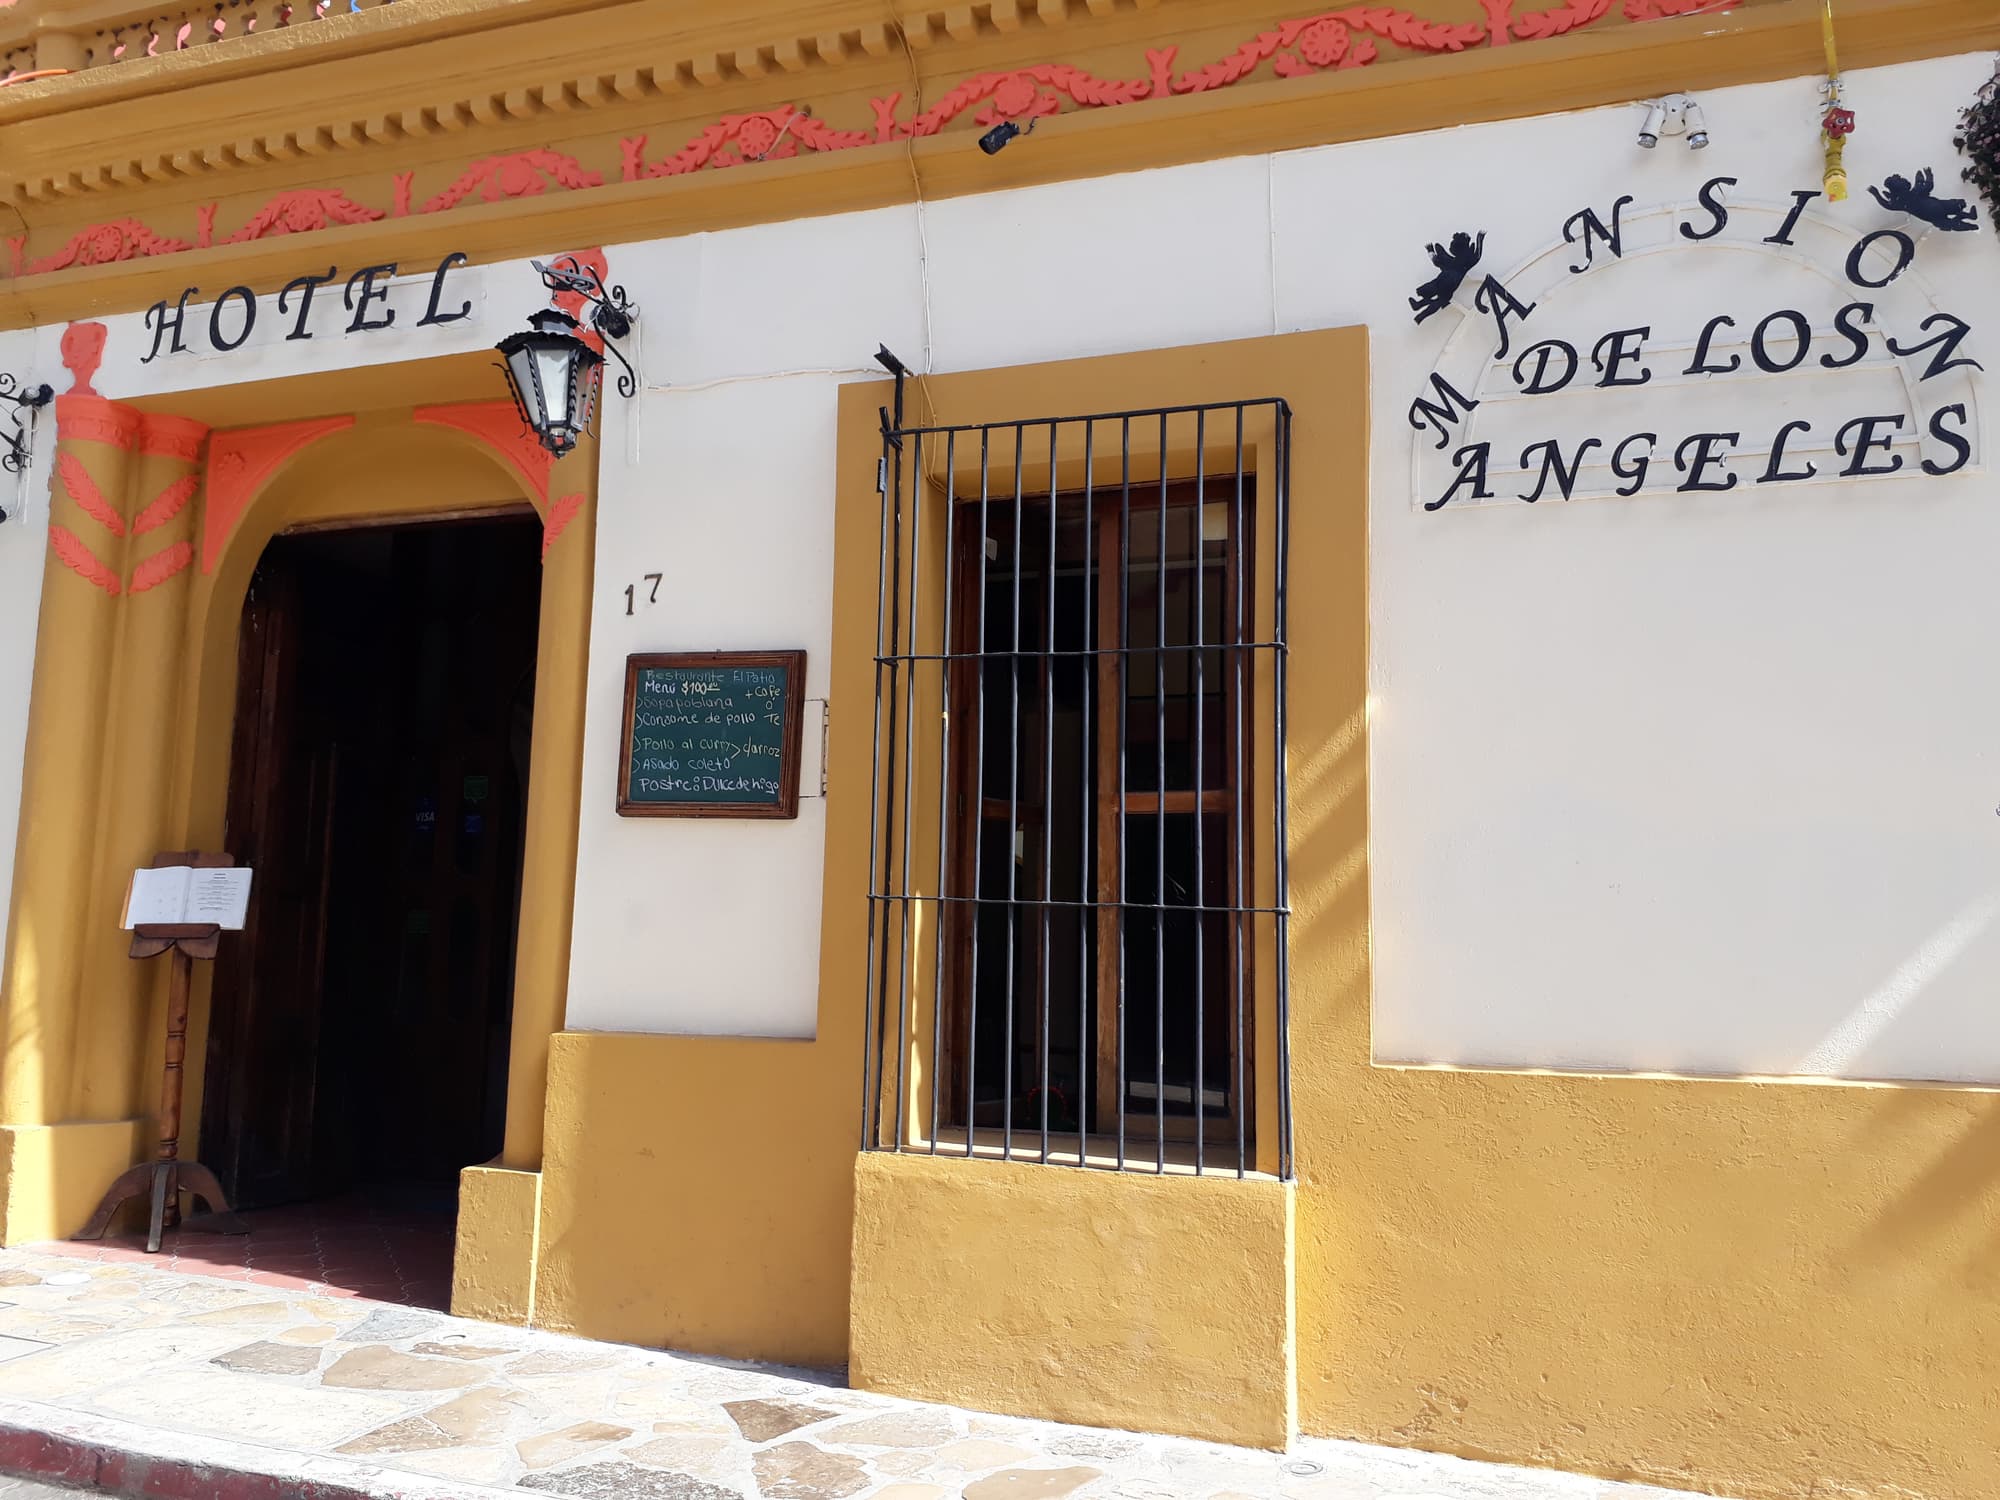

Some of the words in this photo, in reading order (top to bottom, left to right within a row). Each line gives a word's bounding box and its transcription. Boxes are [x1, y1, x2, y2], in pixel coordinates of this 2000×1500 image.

[141, 252, 471, 364] HOTEL
[1408, 177, 1984, 448] MANSION
[1512, 326, 1650, 395] DE
[1682, 302, 1875, 376] LOS
[1424, 403, 1971, 512] ANGELES
[624, 573, 663, 615] 17
[644, 680, 676, 694] Menú
[646, 669, 724, 683] Restaurante
[704, 711, 722, 724] de
[726, 712, 756, 726] pollo
[642, 737, 675, 750] Pollo
[682, 738, 693, 750] al
[700, 738, 731, 751] curry
[415, 811, 436, 823] VISA
